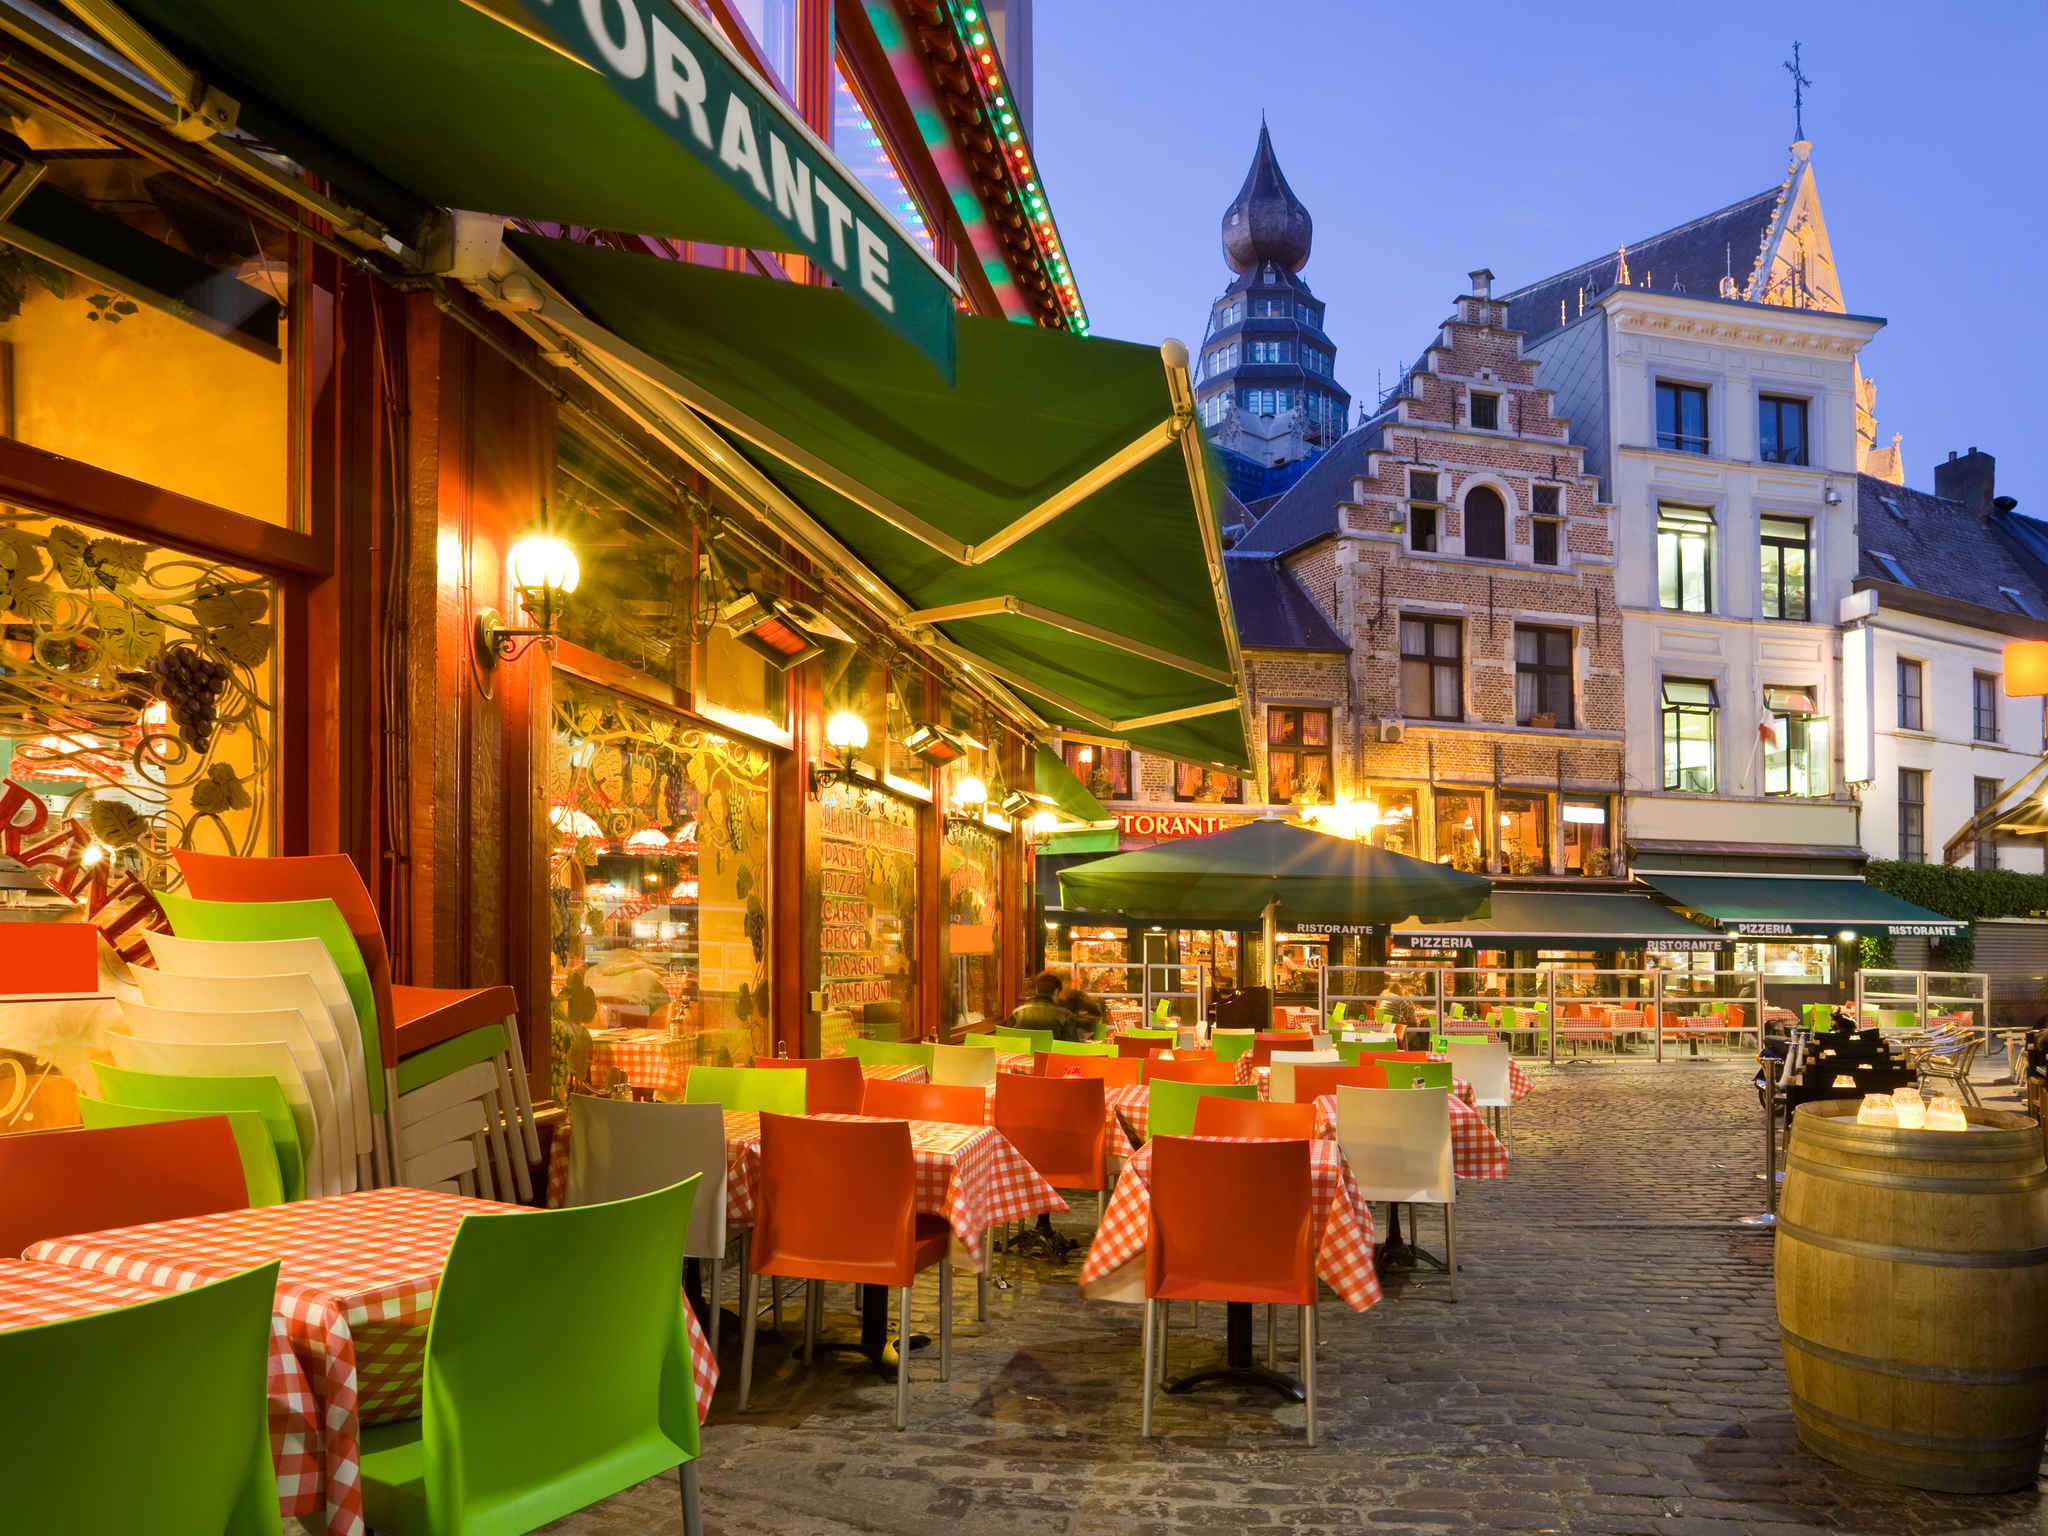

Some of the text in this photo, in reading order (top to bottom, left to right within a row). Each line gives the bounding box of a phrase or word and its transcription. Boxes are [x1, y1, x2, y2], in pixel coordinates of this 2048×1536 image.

[541, 0, 894, 313] ORANTE
[824, 872, 864, 896] PIZZE
[823, 900, 865, 923] CARNE
[1296, 923, 1374, 935] RISTORANTE
[1738, 924, 1793, 935] PIZZERIA
[1887, 925, 1957, 936] RISTORANTE
[824, 928, 865, 950] PESCE
[1410, 937, 1473, 949] PIZZERIA
[1647, 940, 1722, 951] RISTORANTE
[824, 956, 880, 977] LASAGNE
